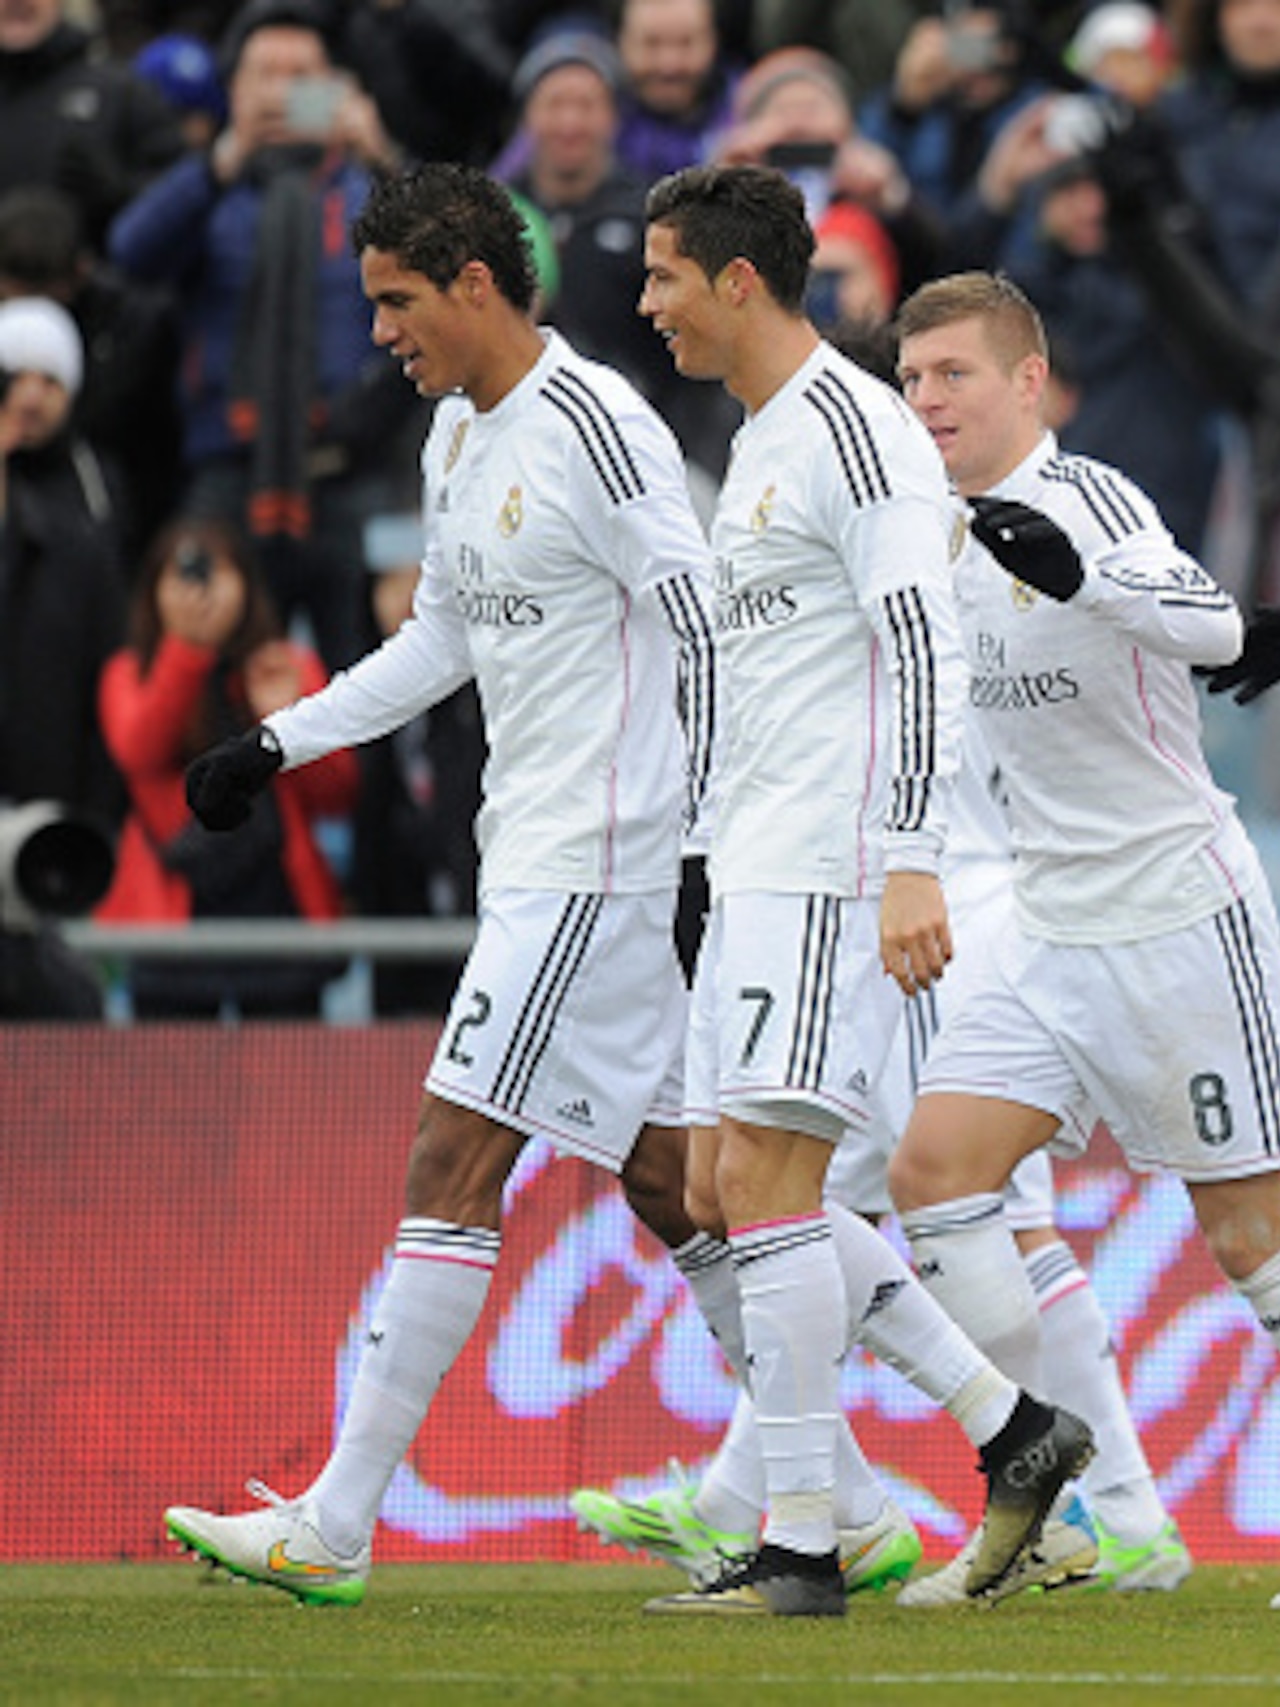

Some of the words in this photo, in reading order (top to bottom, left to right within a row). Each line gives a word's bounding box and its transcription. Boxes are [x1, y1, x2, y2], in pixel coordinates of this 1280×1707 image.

[446, 988, 491, 1068] 2
[739, 986, 775, 1068] 7
[1189, 1073, 1233, 1146] 8
